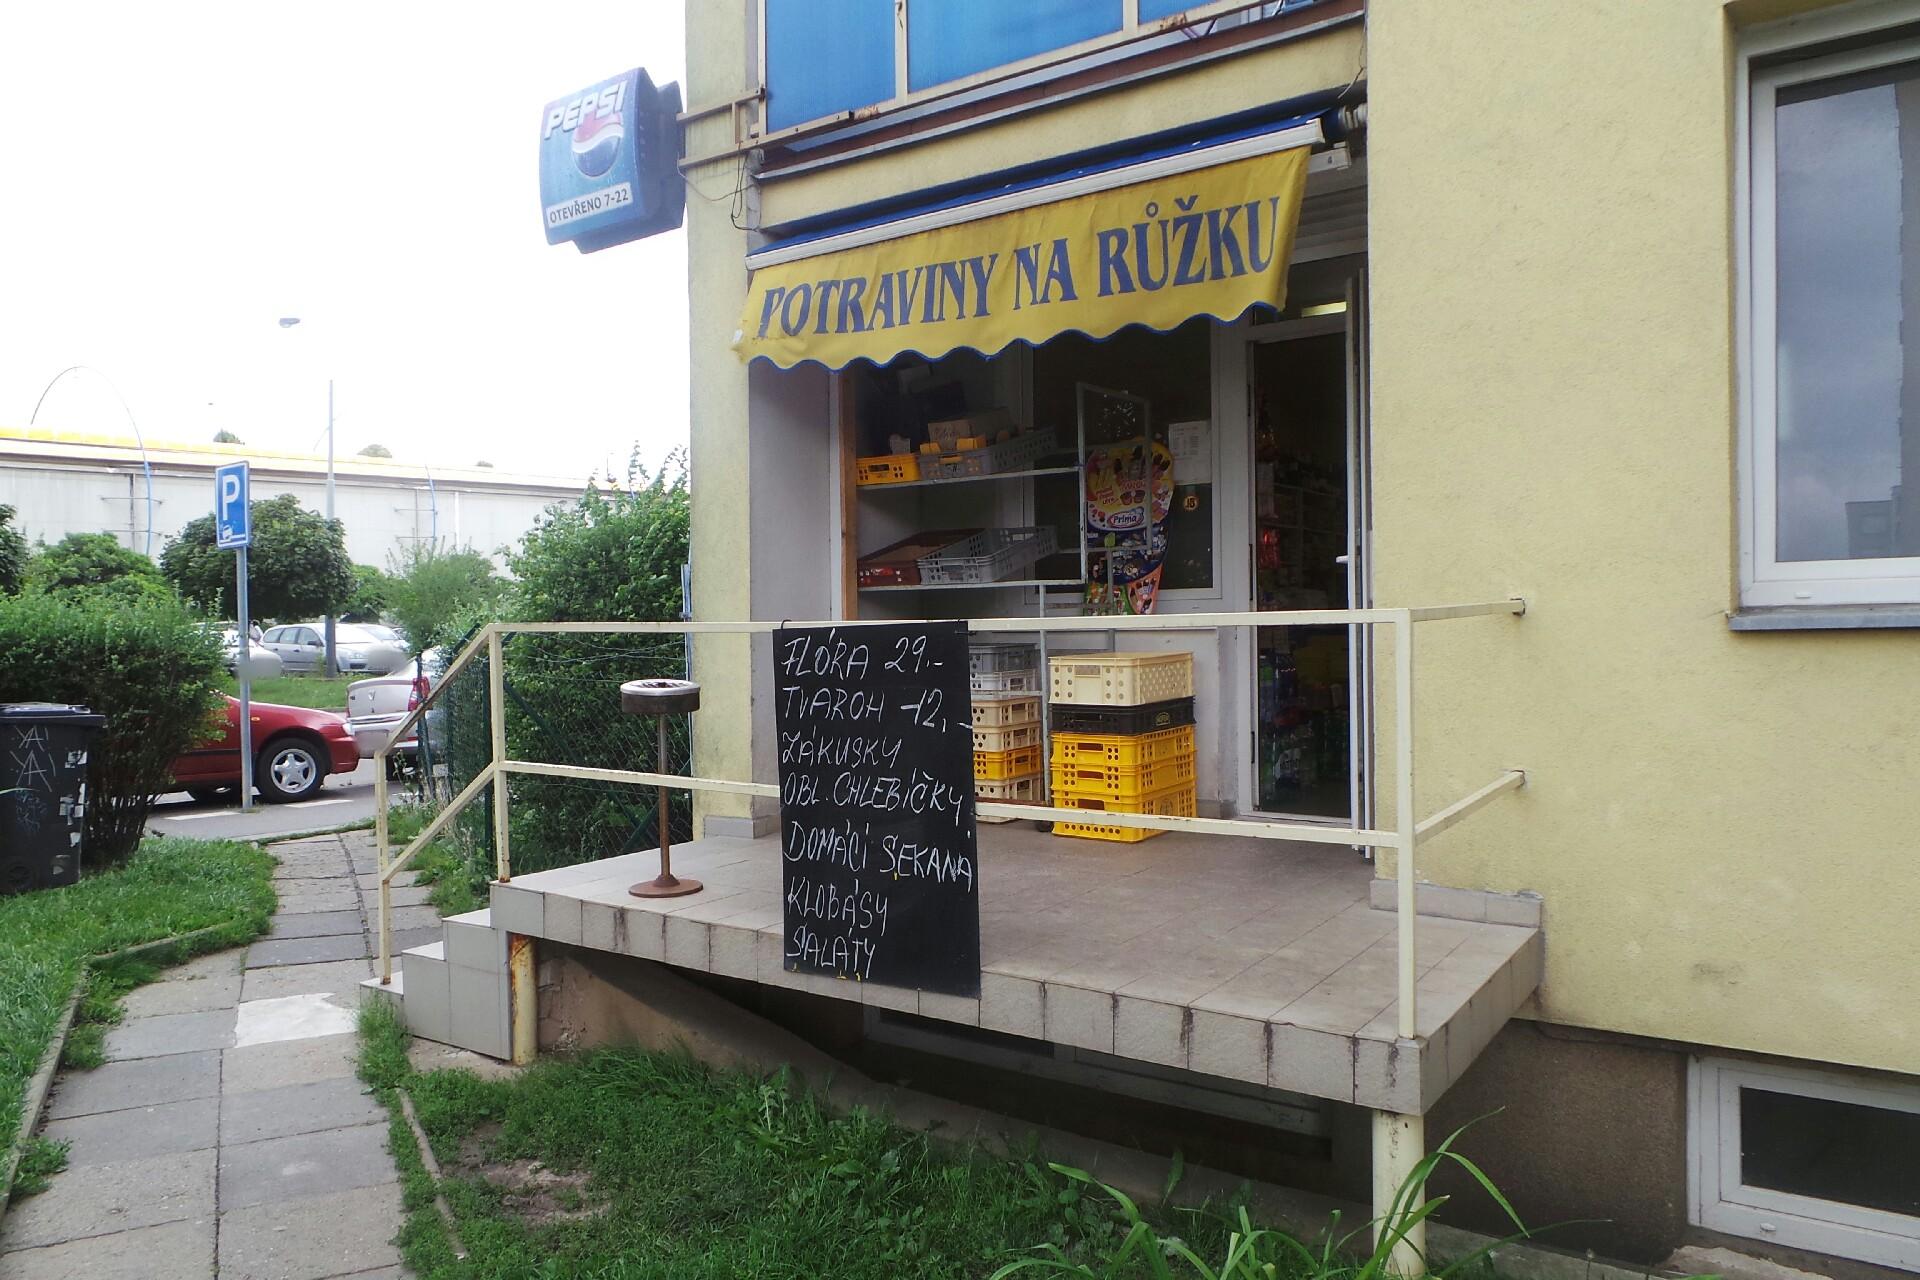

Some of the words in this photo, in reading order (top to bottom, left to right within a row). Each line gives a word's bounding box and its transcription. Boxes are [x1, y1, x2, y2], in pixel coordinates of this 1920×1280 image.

[543, 80, 628, 140] PEPSI
[549, 197, 602, 224] OTEVŘENO
[603, 188, 629, 208] 7-22
[758, 253, 999, 340] POTRAVINY
[1012, 237, 1078, 311] NA
[1096, 194, 1280, 299] RŮŽKU
[222, 474, 241, 521] P
[1113, 514, 1137, 525] Prima
[781, 627, 869, 680] FLÓRA
[782, 685, 885, 723] TVAROH
[782, 725, 903, 768] ZÁKUSKY
[833, 768, 964, 826] CHLEBÍČKY
[783, 818, 871, 873] DOMÁCÍ
[786, 876, 889, 937] KLOBÁSY
